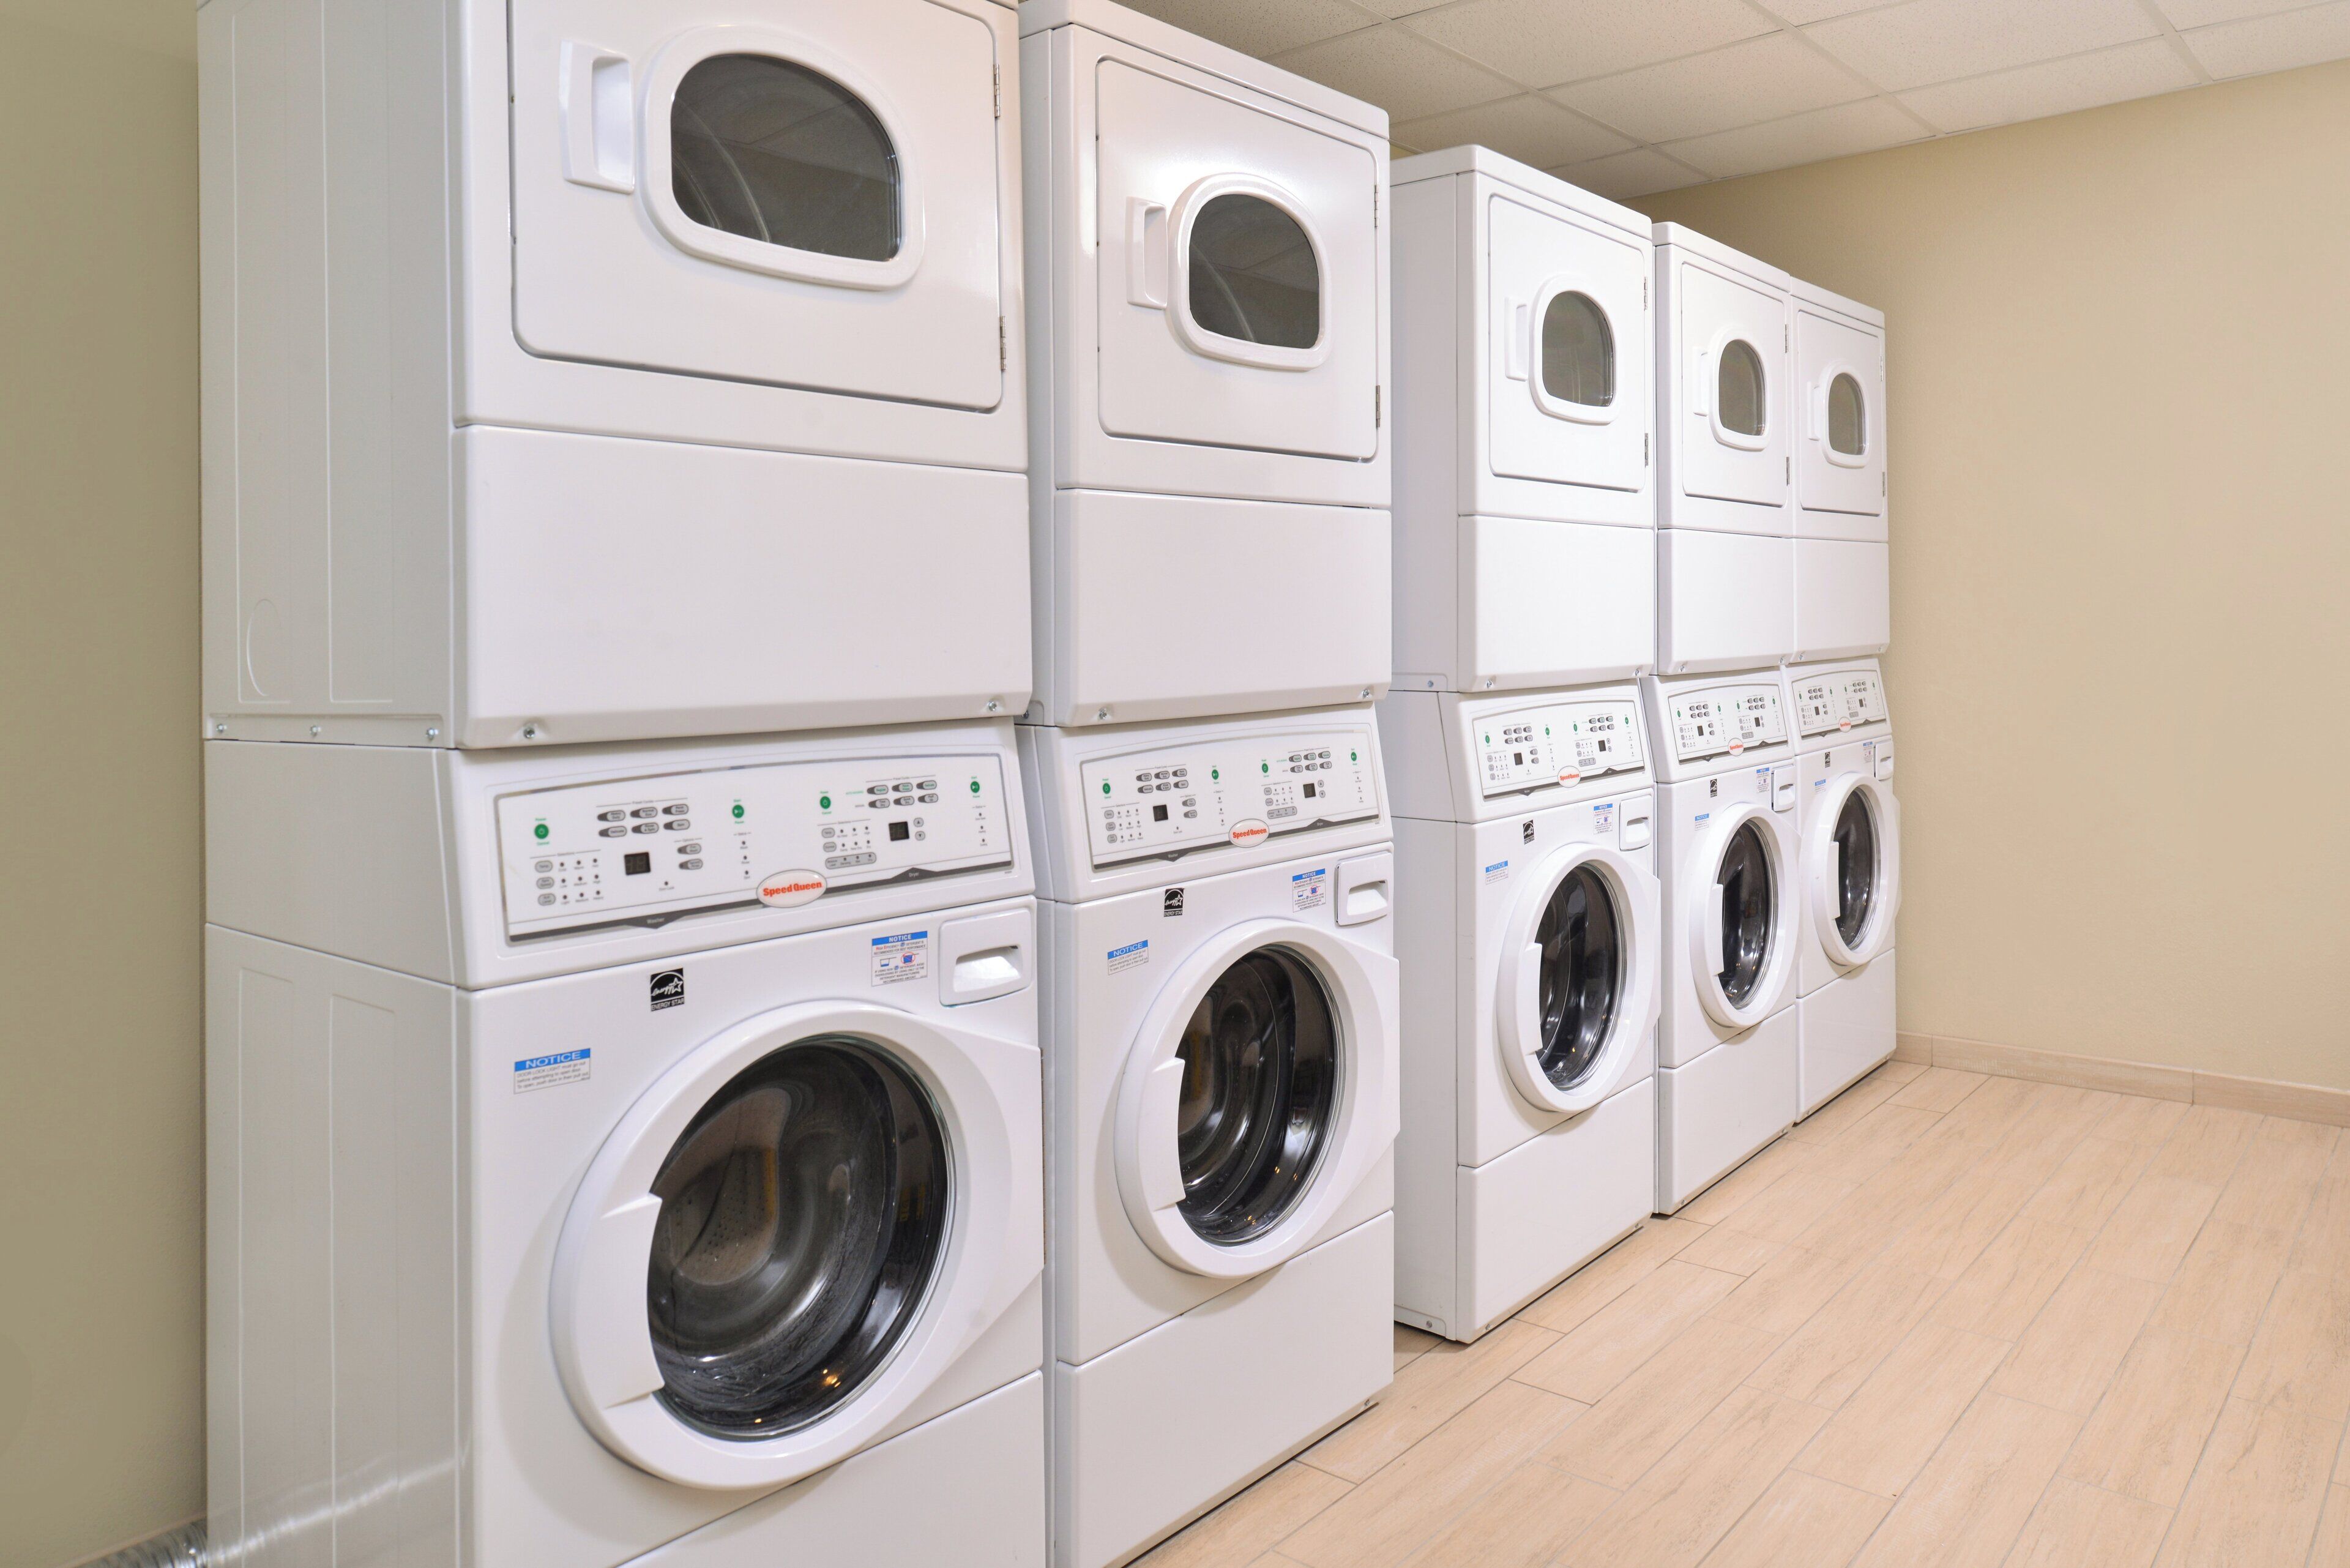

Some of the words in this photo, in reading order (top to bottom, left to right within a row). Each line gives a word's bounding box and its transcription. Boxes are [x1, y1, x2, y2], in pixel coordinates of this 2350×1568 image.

[1233, 830, 1250, 839] Speed
[1489, 862, 1505, 872] NOTICE
[763, 884, 793, 897] Speed
[793, 882, 822, 891] Queen
[889, 934, 911, 943] NOTICE
[1113, 943, 1143, 957] NOTICE
[651, 1001, 671, 1010] ENERGY
[671, 998, 684, 1006] STAR
[526, 1051, 581, 1069] NOTICE
